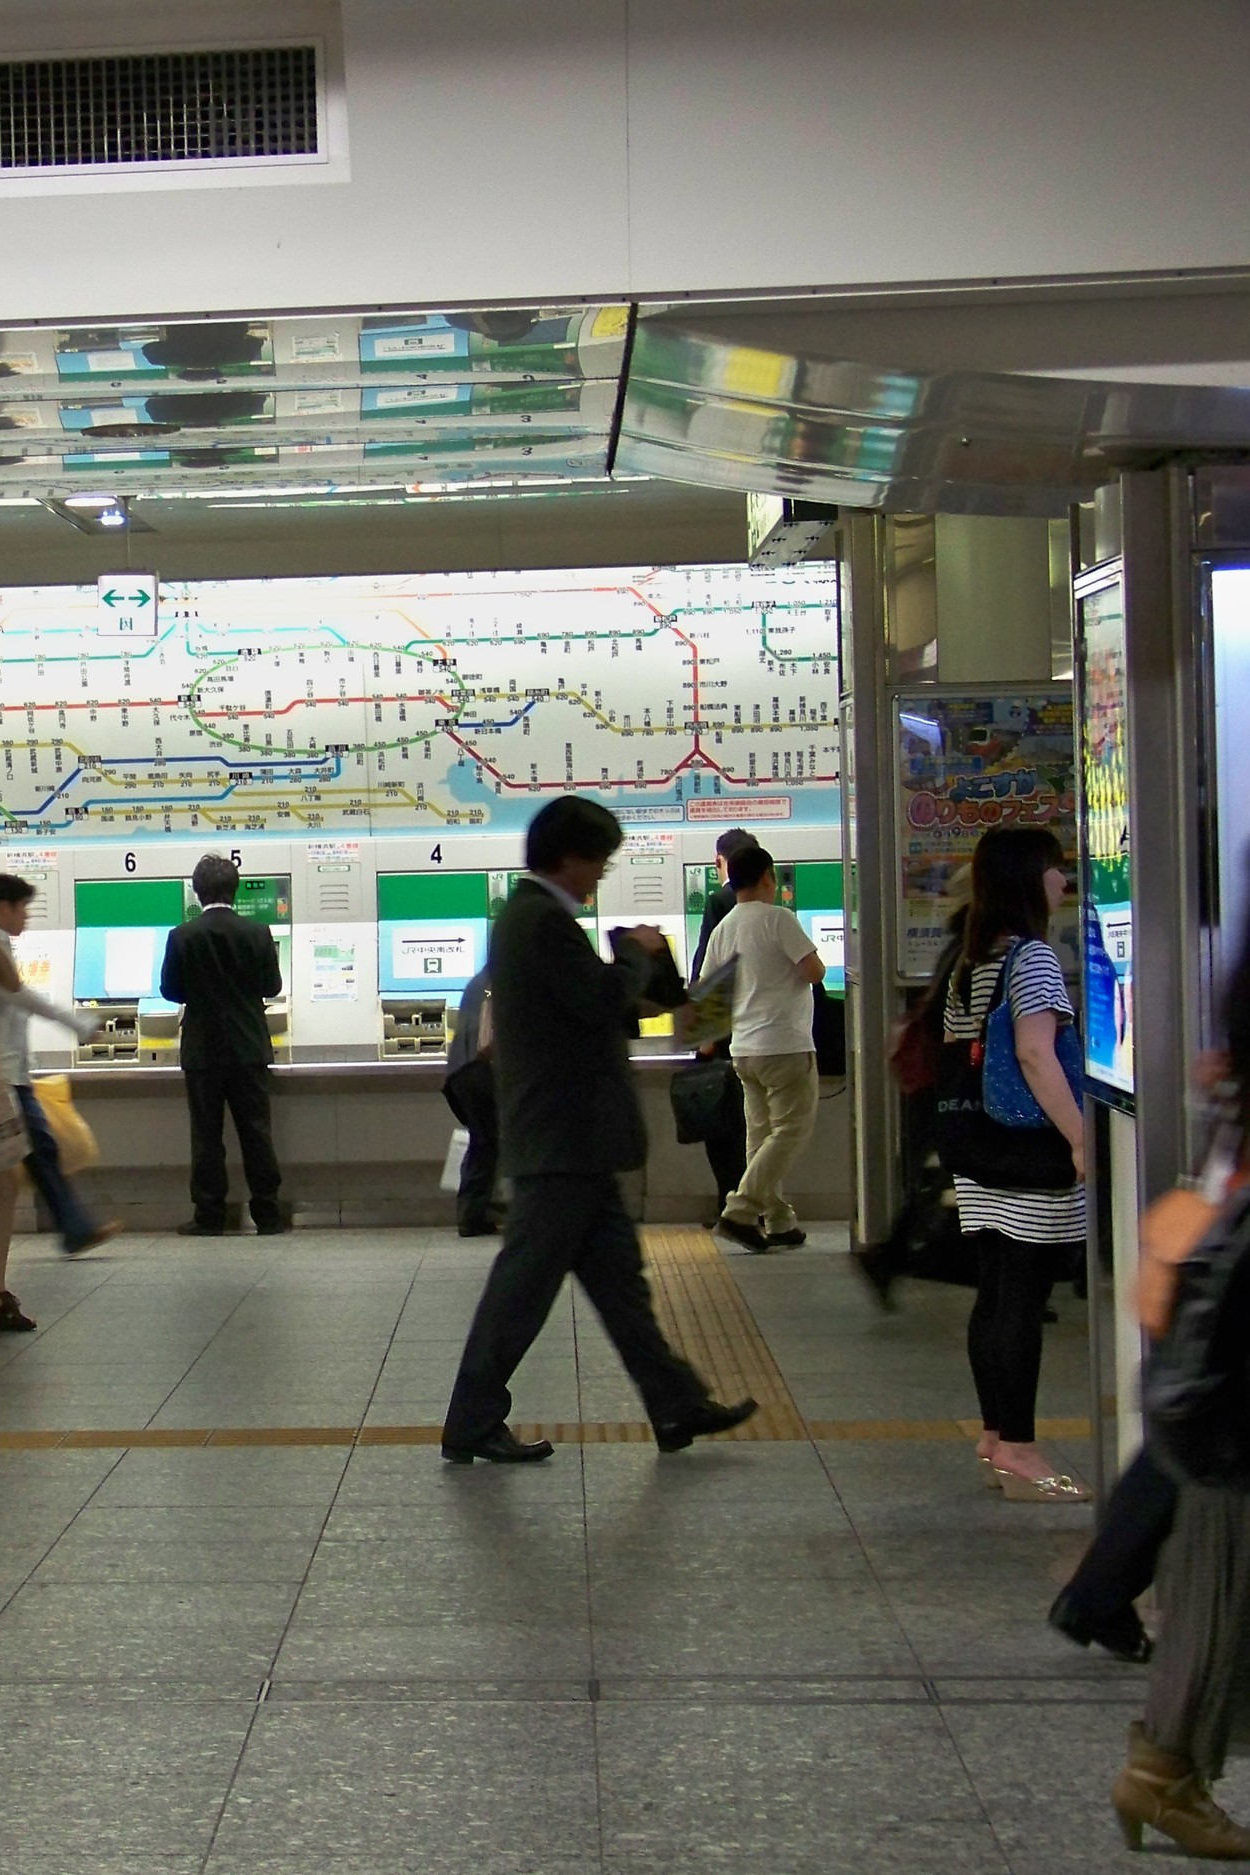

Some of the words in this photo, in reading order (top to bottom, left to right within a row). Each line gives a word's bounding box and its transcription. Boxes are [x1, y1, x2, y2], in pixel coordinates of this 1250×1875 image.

[790, 663, 797, 675] 木下
[812, 662, 819, 674] 小林
[90, 710, 96, 721] 中野
[230, 850, 241, 869] 5
[431, 844, 442, 864] 4
[125, 853, 136, 872] 6
[690, 867, 701, 875] JR
[402, 946, 464, 955] JR中央南改札
